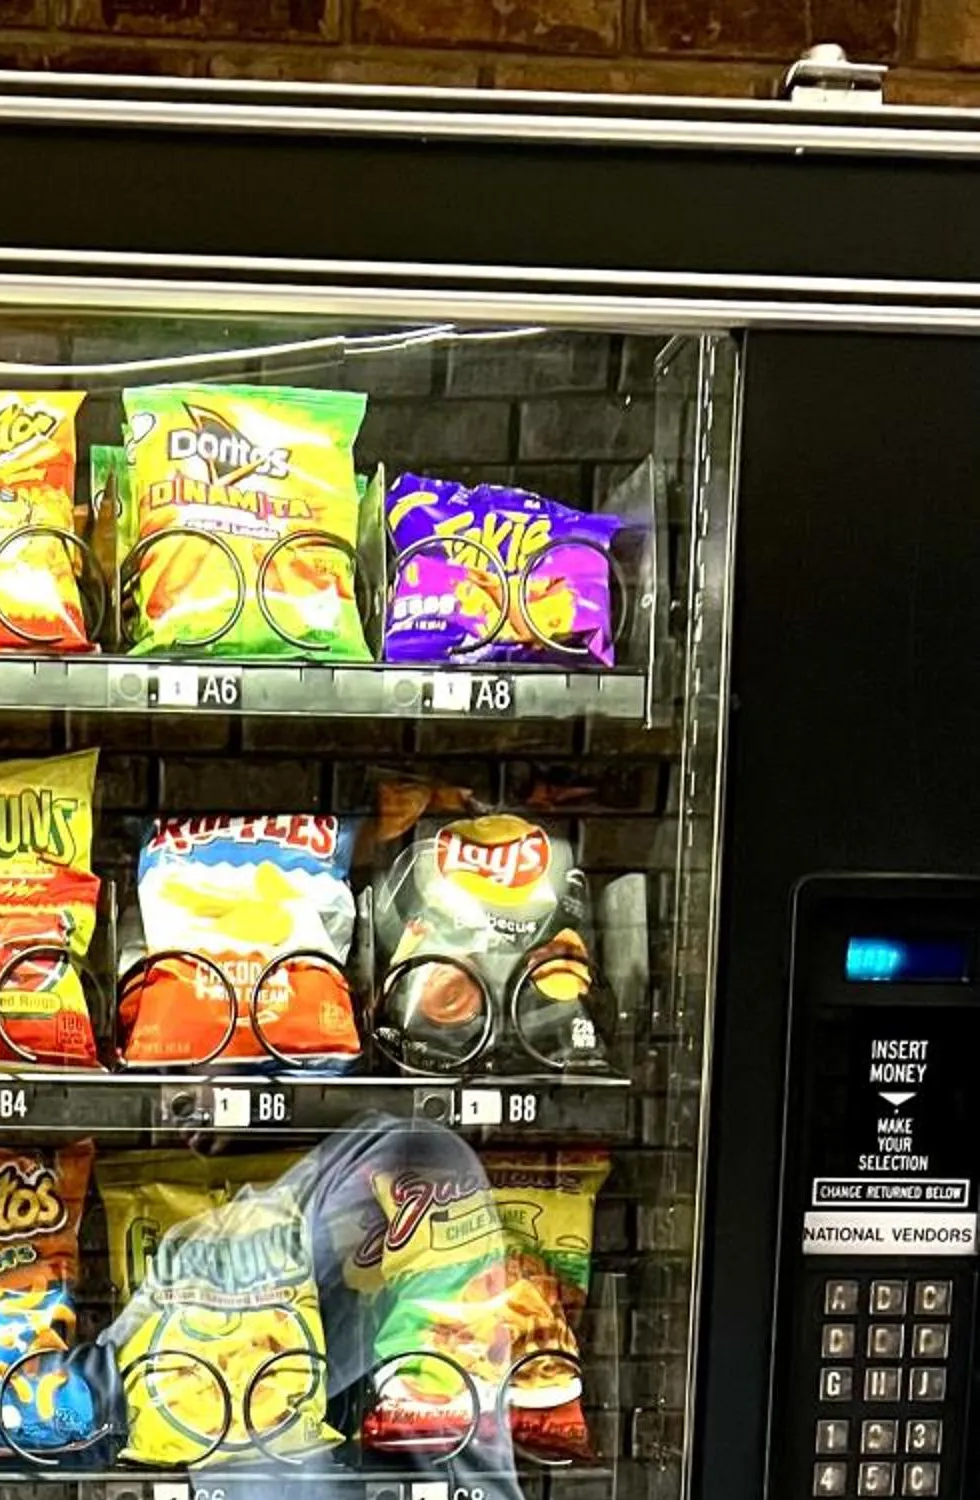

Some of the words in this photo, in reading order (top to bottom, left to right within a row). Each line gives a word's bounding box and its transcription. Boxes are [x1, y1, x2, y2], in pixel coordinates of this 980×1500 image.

[166, 428, 292, 479] Doritos
[202, 676, 238, 704] A6
[475, 678, 510, 710] A8
[870, 1039, 929, 1061] INSERT
[870, 1063, 927, 1084] MONEY
[0, 1090, 28, 1118] B4
[258, 1093, 286, 1121] B6
[509, 1094, 537, 1122] B8
[877, 1117, 913, 1135] MAKE
[877, 1136, 913, 1153] YOUR
[858, 1154, 929, 1172] SELECTION
[820, 1184, 862, 1200] CHANGE
[866, 1185, 922, 1200] RETURNED
[925, 1185, 962, 1201] BELOW
[803, 1226, 885, 1243] NATIONAL
[892, 1227, 973, 1244] VENDORS
[831, 1285, 847, 1311] A
[922, 1284, 937, 1310] C
[827, 1371, 841, 1397] G
[917, 1370, 930, 1395] J
[826, 1423, 836, 1449] 1
[913, 1423, 927, 1449] 3
[819, 1466, 834, 1491] 4
[865, 1466, 880, 1491] 5
